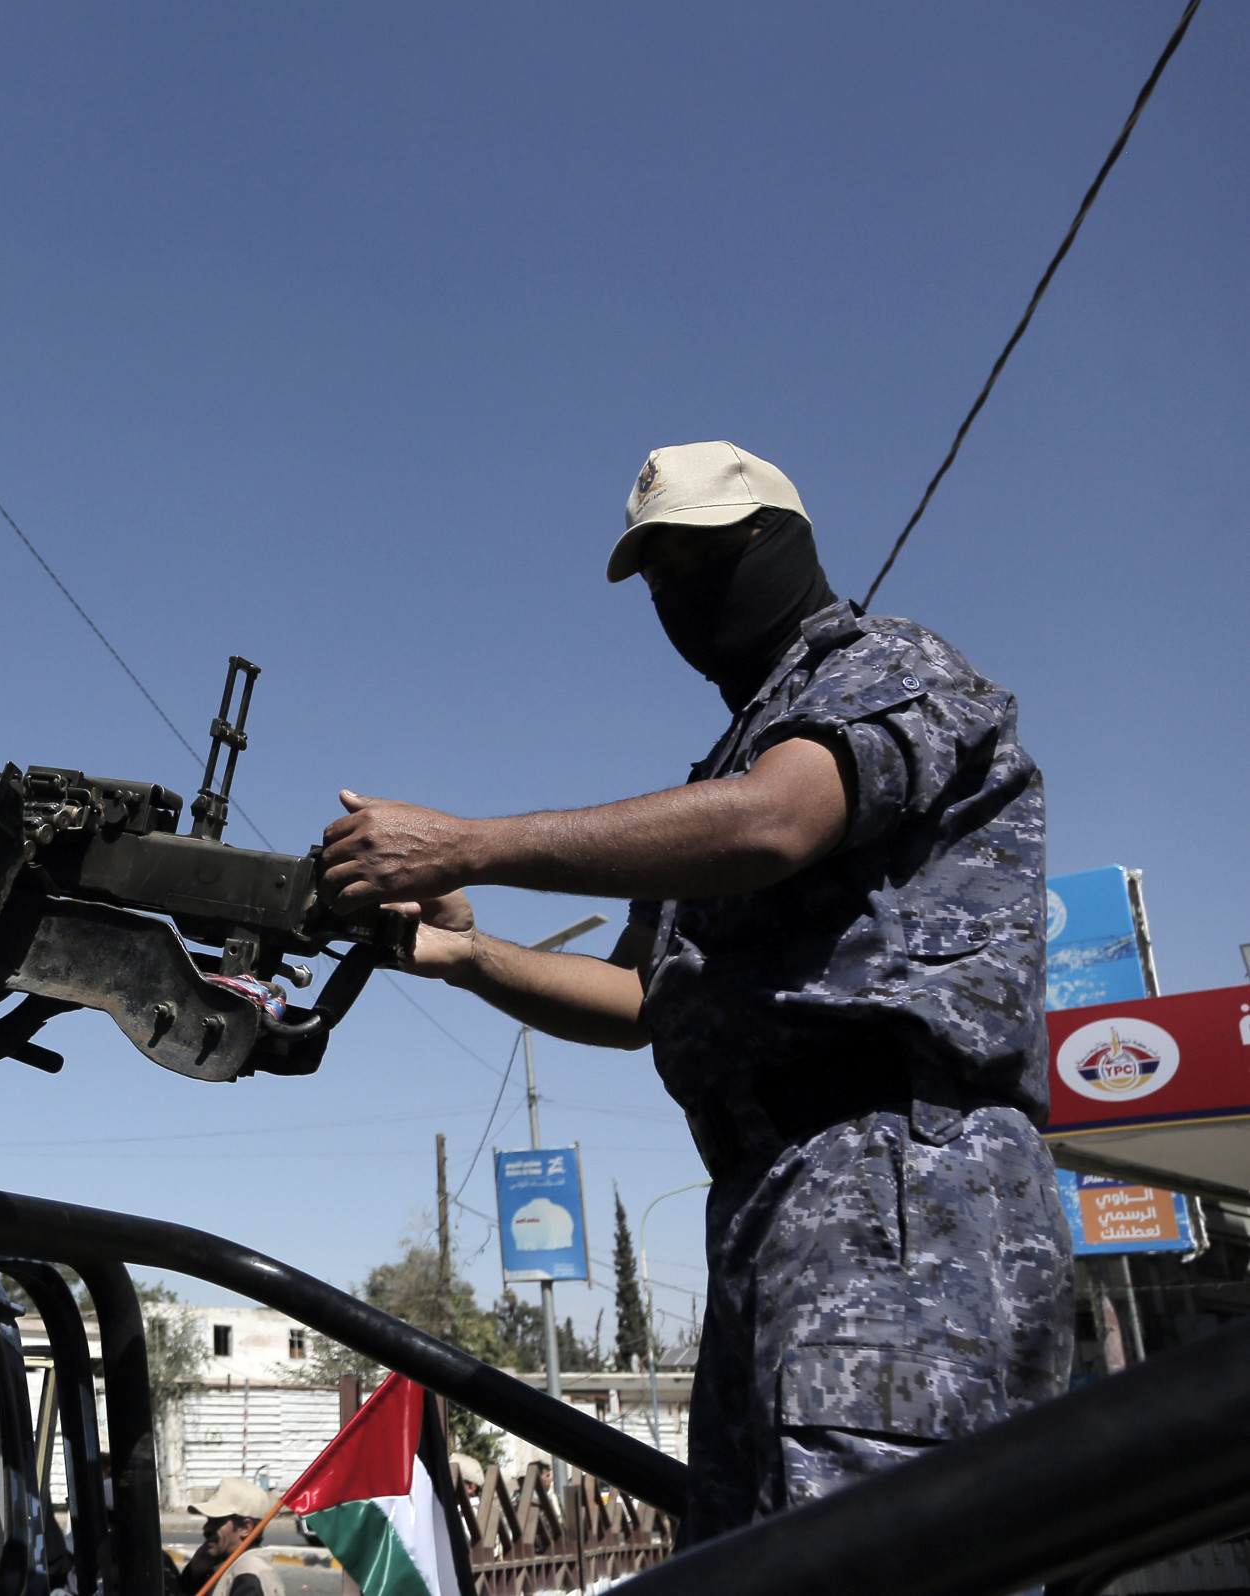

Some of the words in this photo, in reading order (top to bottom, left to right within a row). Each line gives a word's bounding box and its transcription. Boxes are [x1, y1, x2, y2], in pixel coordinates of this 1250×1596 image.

[1105, 1064, 1133, 1077] YPC
[1098, 1206, 1157, 1227] الرسمي
[1100, 1224, 1161, 1240] لعطشك
